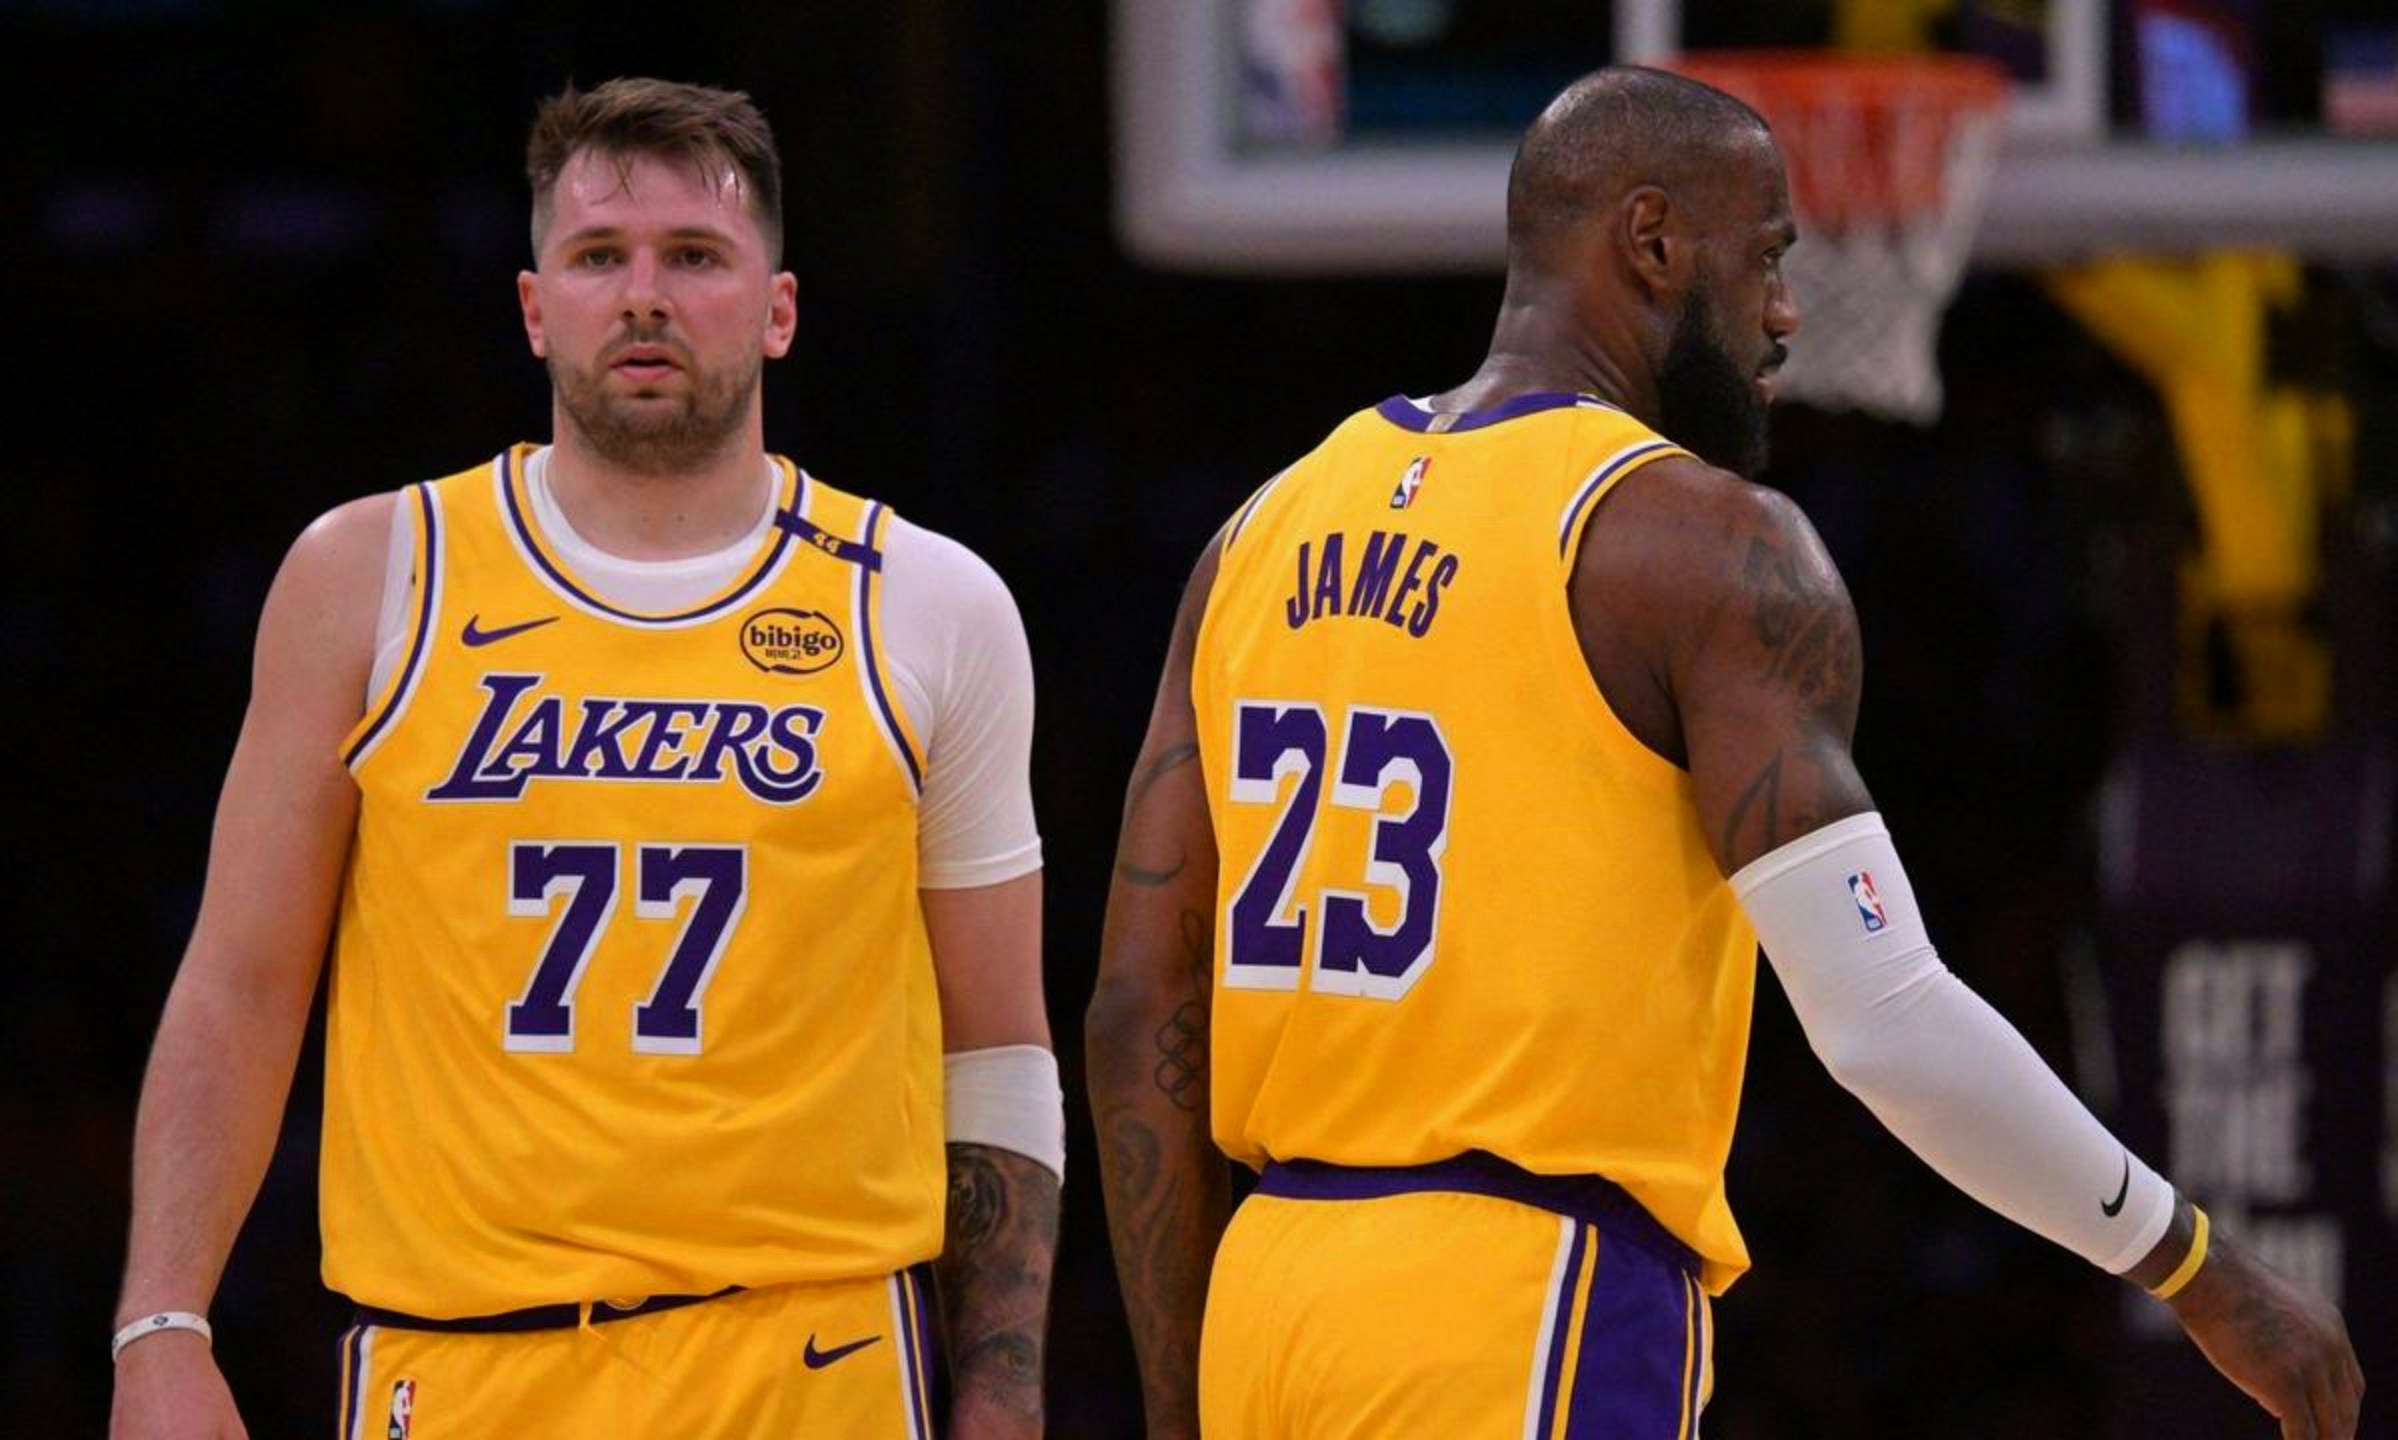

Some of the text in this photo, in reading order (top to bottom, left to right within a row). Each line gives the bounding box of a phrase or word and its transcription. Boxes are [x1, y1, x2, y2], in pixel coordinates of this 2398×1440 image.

[751, 625, 837, 656] bibigo
[1286, 531, 1458, 638] JAMES
[424, 672, 825, 803] LAKERS
[1223, 699, 1454, 1000] 23
[505, 840, 748, 1054] 77
